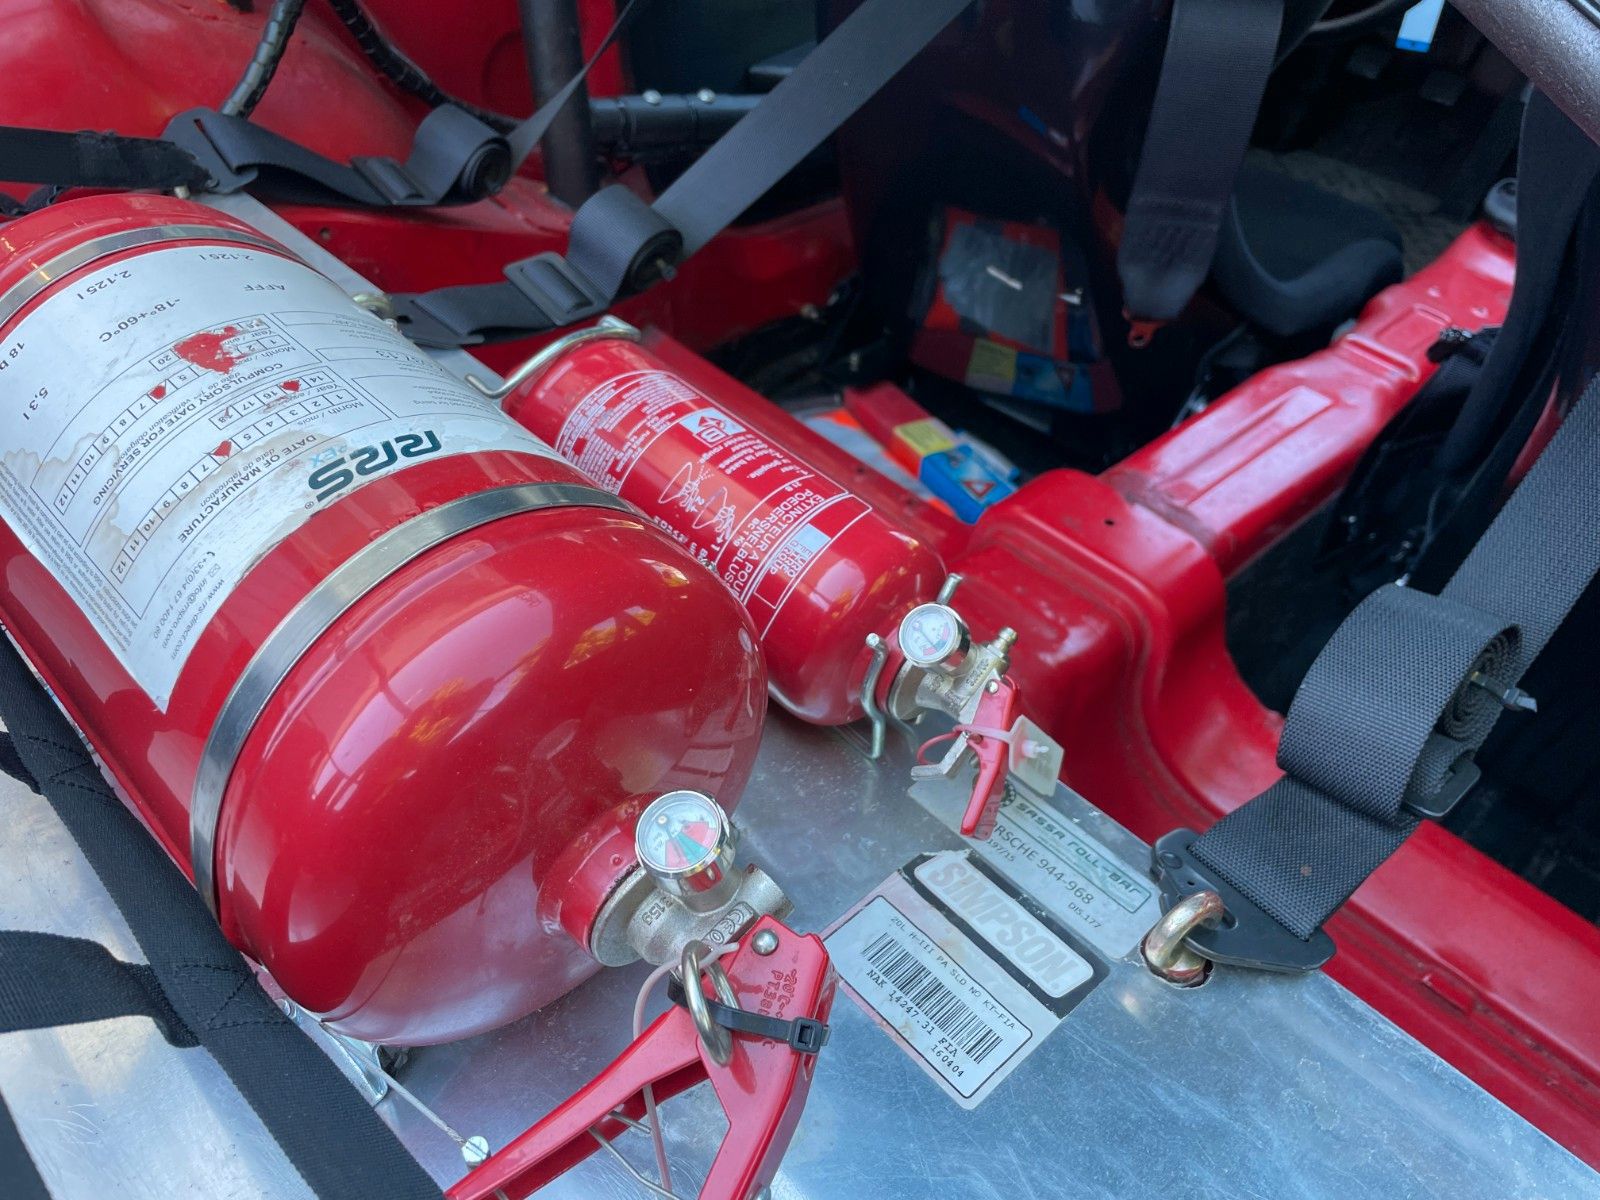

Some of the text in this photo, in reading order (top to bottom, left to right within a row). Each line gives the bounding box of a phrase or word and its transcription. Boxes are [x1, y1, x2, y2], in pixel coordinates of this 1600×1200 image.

[85, 268, 131, 295] 2,125
[242, 283, 285, 293] AFFF
[97, 295, 181, 343] -18°+60°C
[251, 328, 273, 338] Year
[7, 340, 25, 358] 18
[260, 344, 294, 359] Month
[156, 353, 172, 366] 20
[178, 373, 187, 382] 5
[198, 361, 282, 405] COMPULSORY
[215, 370, 240, 387] date
[310, 373, 323, 382] 14
[202, 383, 214, 394] de
[262, 389, 276, 400] 16
[315, 381, 338, 393] Year
[27, 386, 49, 411] 5,3
[136, 400, 146, 411] 7
[241, 399, 255, 410] 17
[148, 396, 191, 432] vérification
[164, 401, 196, 427] DATE
[327, 400, 362, 416] Month
[117, 417, 127, 428] 8
[264, 419, 274, 428] 4
[100, 434, 110, 445] 9
[139, 425, 165, 448] FOR
[242, 432, 252, 441] 5
[82, 452, 96, 467] 10
[199, 462, 209, 472] 7
[304, 428, 442, 503] RRS
[68, 471, 81, 486] 11
[90, 446, 141, 506] SERVICING
[198, 447, 276, 508] date de fabrication
[176, 433, 316, 541] DATE OF MANUFACTURE
[179, 480, 189, 491] 8
[57, 491, 70, 507] 12
[161, 499, 171, 509] 9
[142, 517, 156, 532] 10
[128, 537, 140, 553] 11
[729, 493, 822, 596] EXTINCTEUR A POU
[115, 558, 127, 574] 12
[169, 578, 225, 660] www.rrs-direct.com
[1015, 800, 1065, 840] SASSA
[988, 820, 1037, 861] RSCHE
[1035, 857, 1095, 905] 944-968
[926, 858, 1078, 985] SIMPSON
[935, 955, 949, 968] PA
[949, 968, 967, 986] SLD
[981, 998, 1016, 1030] KT-FIA
[866, 968, 959, 1057] NAK 14247.31 FIA
[929, 1043, 965, 1078] 160404
